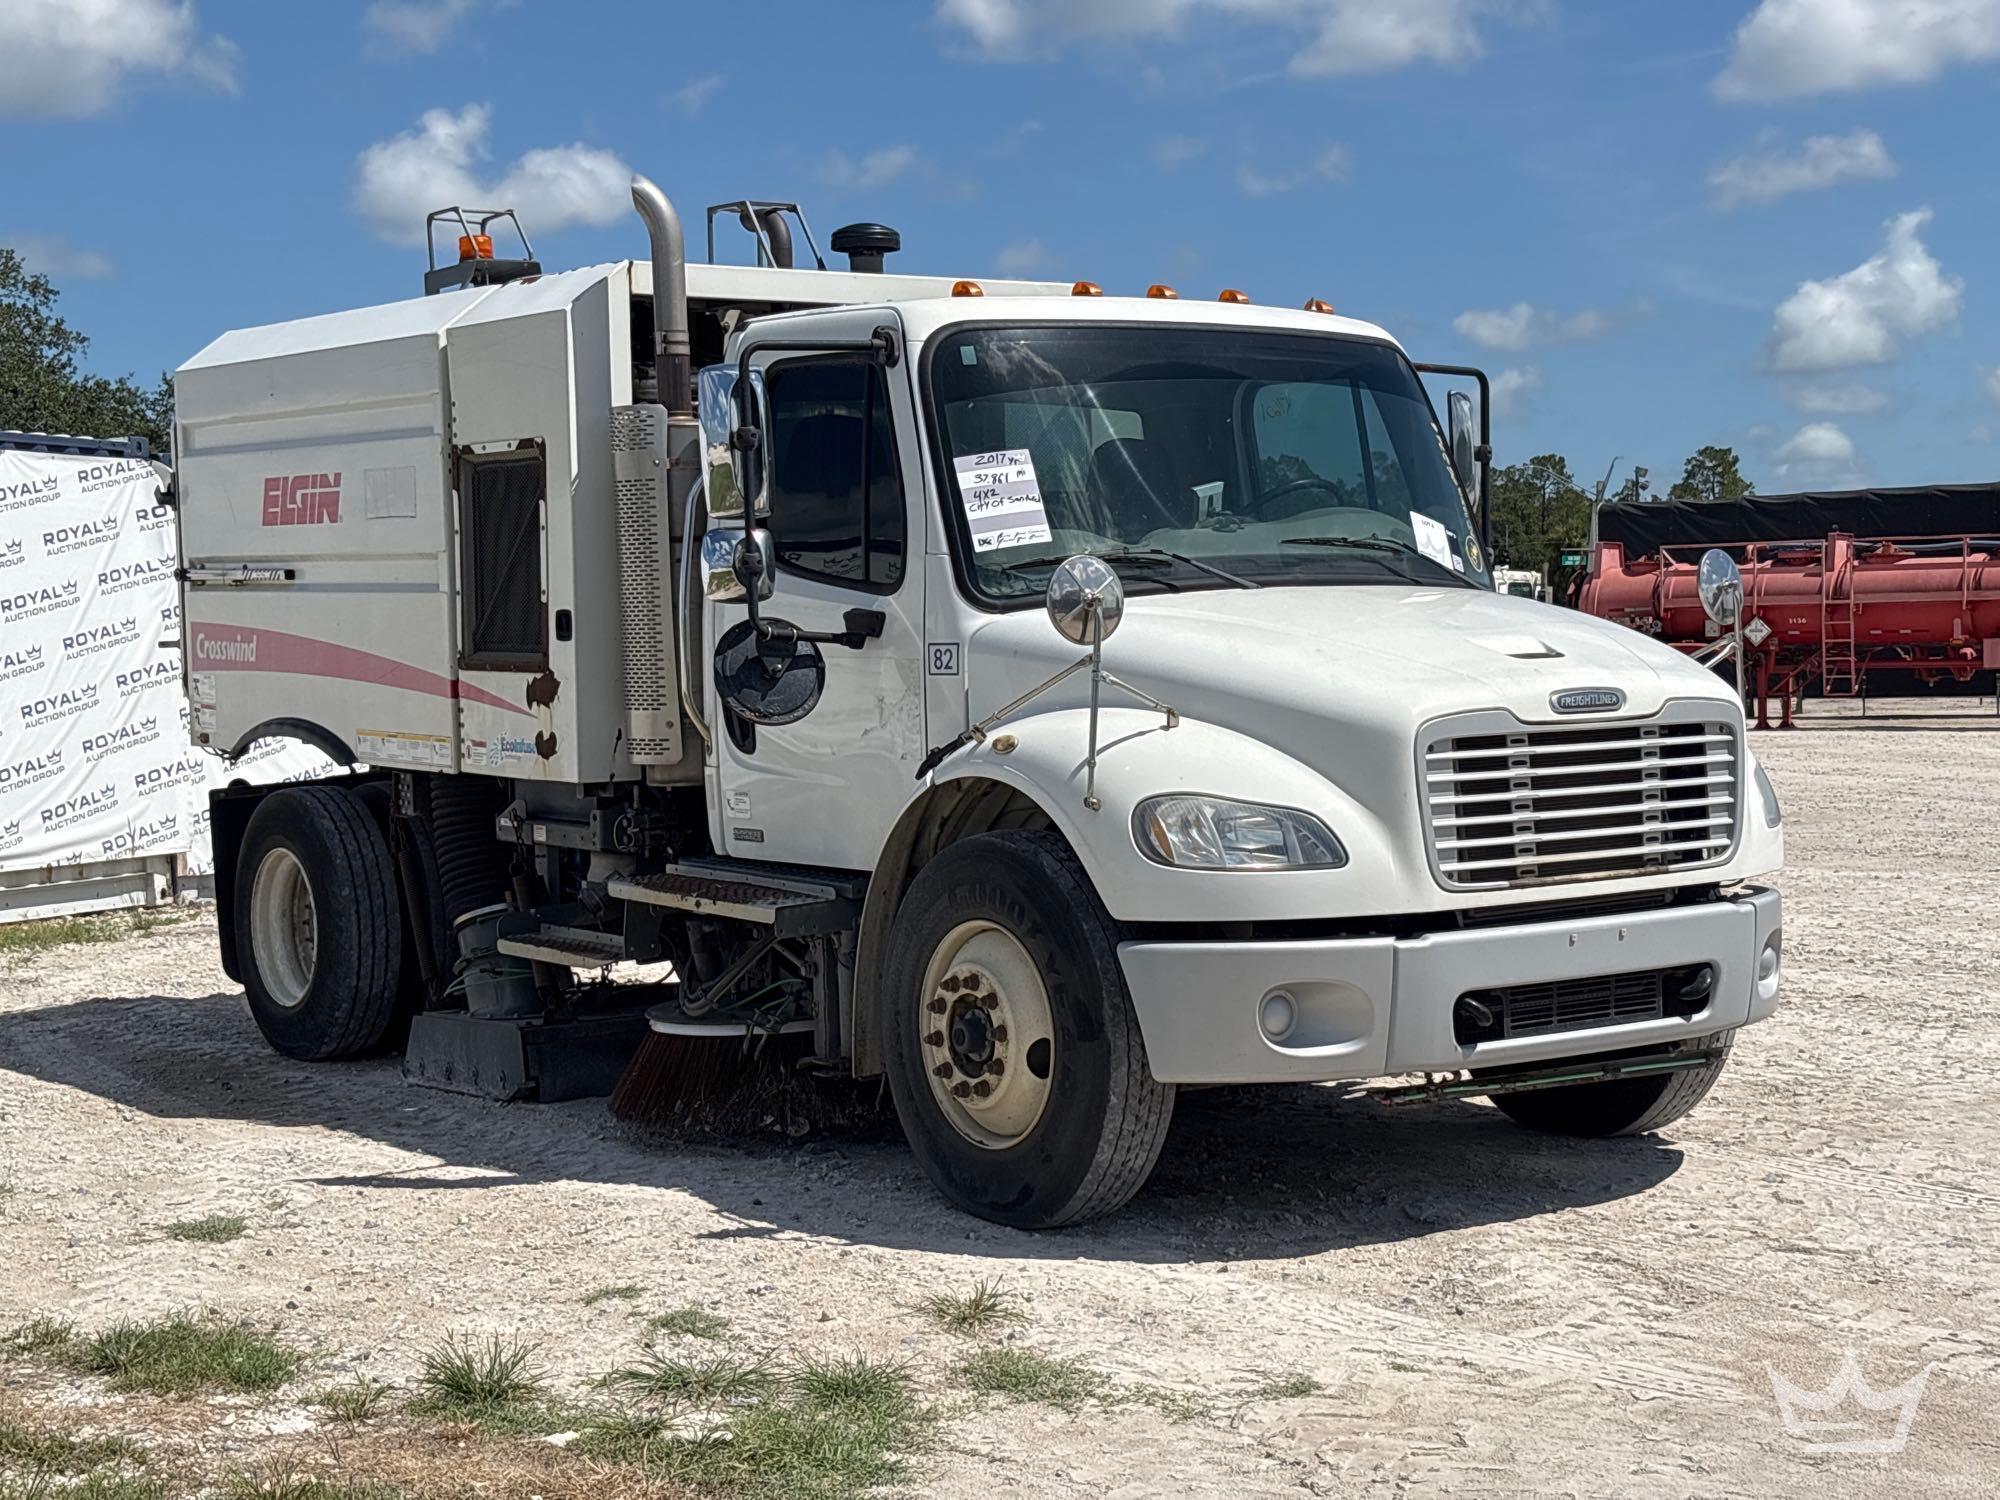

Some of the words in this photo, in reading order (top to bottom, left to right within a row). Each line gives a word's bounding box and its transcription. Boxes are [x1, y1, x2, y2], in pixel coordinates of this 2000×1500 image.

[78, 459, 136, 484] ROYAL
[974, 453, 1007, 466] 2017
[0, 480, 43, 502] OYAL
[81, 478, 121, 494] AUCTION
[0, 500, 27, 514] CTION
[28, 492, 62, 506] GROUP
[262, 472, 341, 527] ELGIN
[42, 520, 103, 547] ROYAL
[139, 518, 176, 533] AUCTI
[47, 540, 88, 557] AUCTION
[88, 531, 121, 546] GROUP
[0, 556, 26, 568] ROUP
[98, 560, 160, 587] ROYAL
[100, 579, 140, 597] AUCTION
[142, 571, 174, 585] GROU
[0, 586, 63, 614] ROYAL
[4, 606, 47, 624] AUCTION
[48, 596, 81, 612] GROUP
[62, 624, 122, 651] ROYAL
[66, 643, 107, 661] AUCTION
[108, 632, 141, 648] GROUP
[196, 632, 257, 663] Crosswind
[12, 661, 46, 678] GROUP
[934, 648, 953, 670] 82
[116, 660, 180, 688] ROYAL
[120, 678, 163, 698] AUCTION
[1560, 694, 1618, 707] FREIGHTLINER
[20, 690, 82, 720] ROYAL
[25, 710, 67, 730] AUCTION
[67, 699, 100, 716] GROUP
[82, 723, 142, 754] ROYAL
[86, 744, 125, 764] AUCTION
[126, 731, 160, 749] GROUP
[260, 744, 287, 760] GROUP
[0, 756, 47, 782] OYAL
[0, 776, 31, 795] CTION
[32, 765, 66, 783] GROUP
[138, 776, 182, 798] AUCTION
[40, 792, 102, 824] ROYAL
[44, 812, 86, 834] AUCTION
[86, 799, 119, 818] GROUP
[102, 822, 160, 854] ROYAL
[146, 830, 180, 848] GROUP
